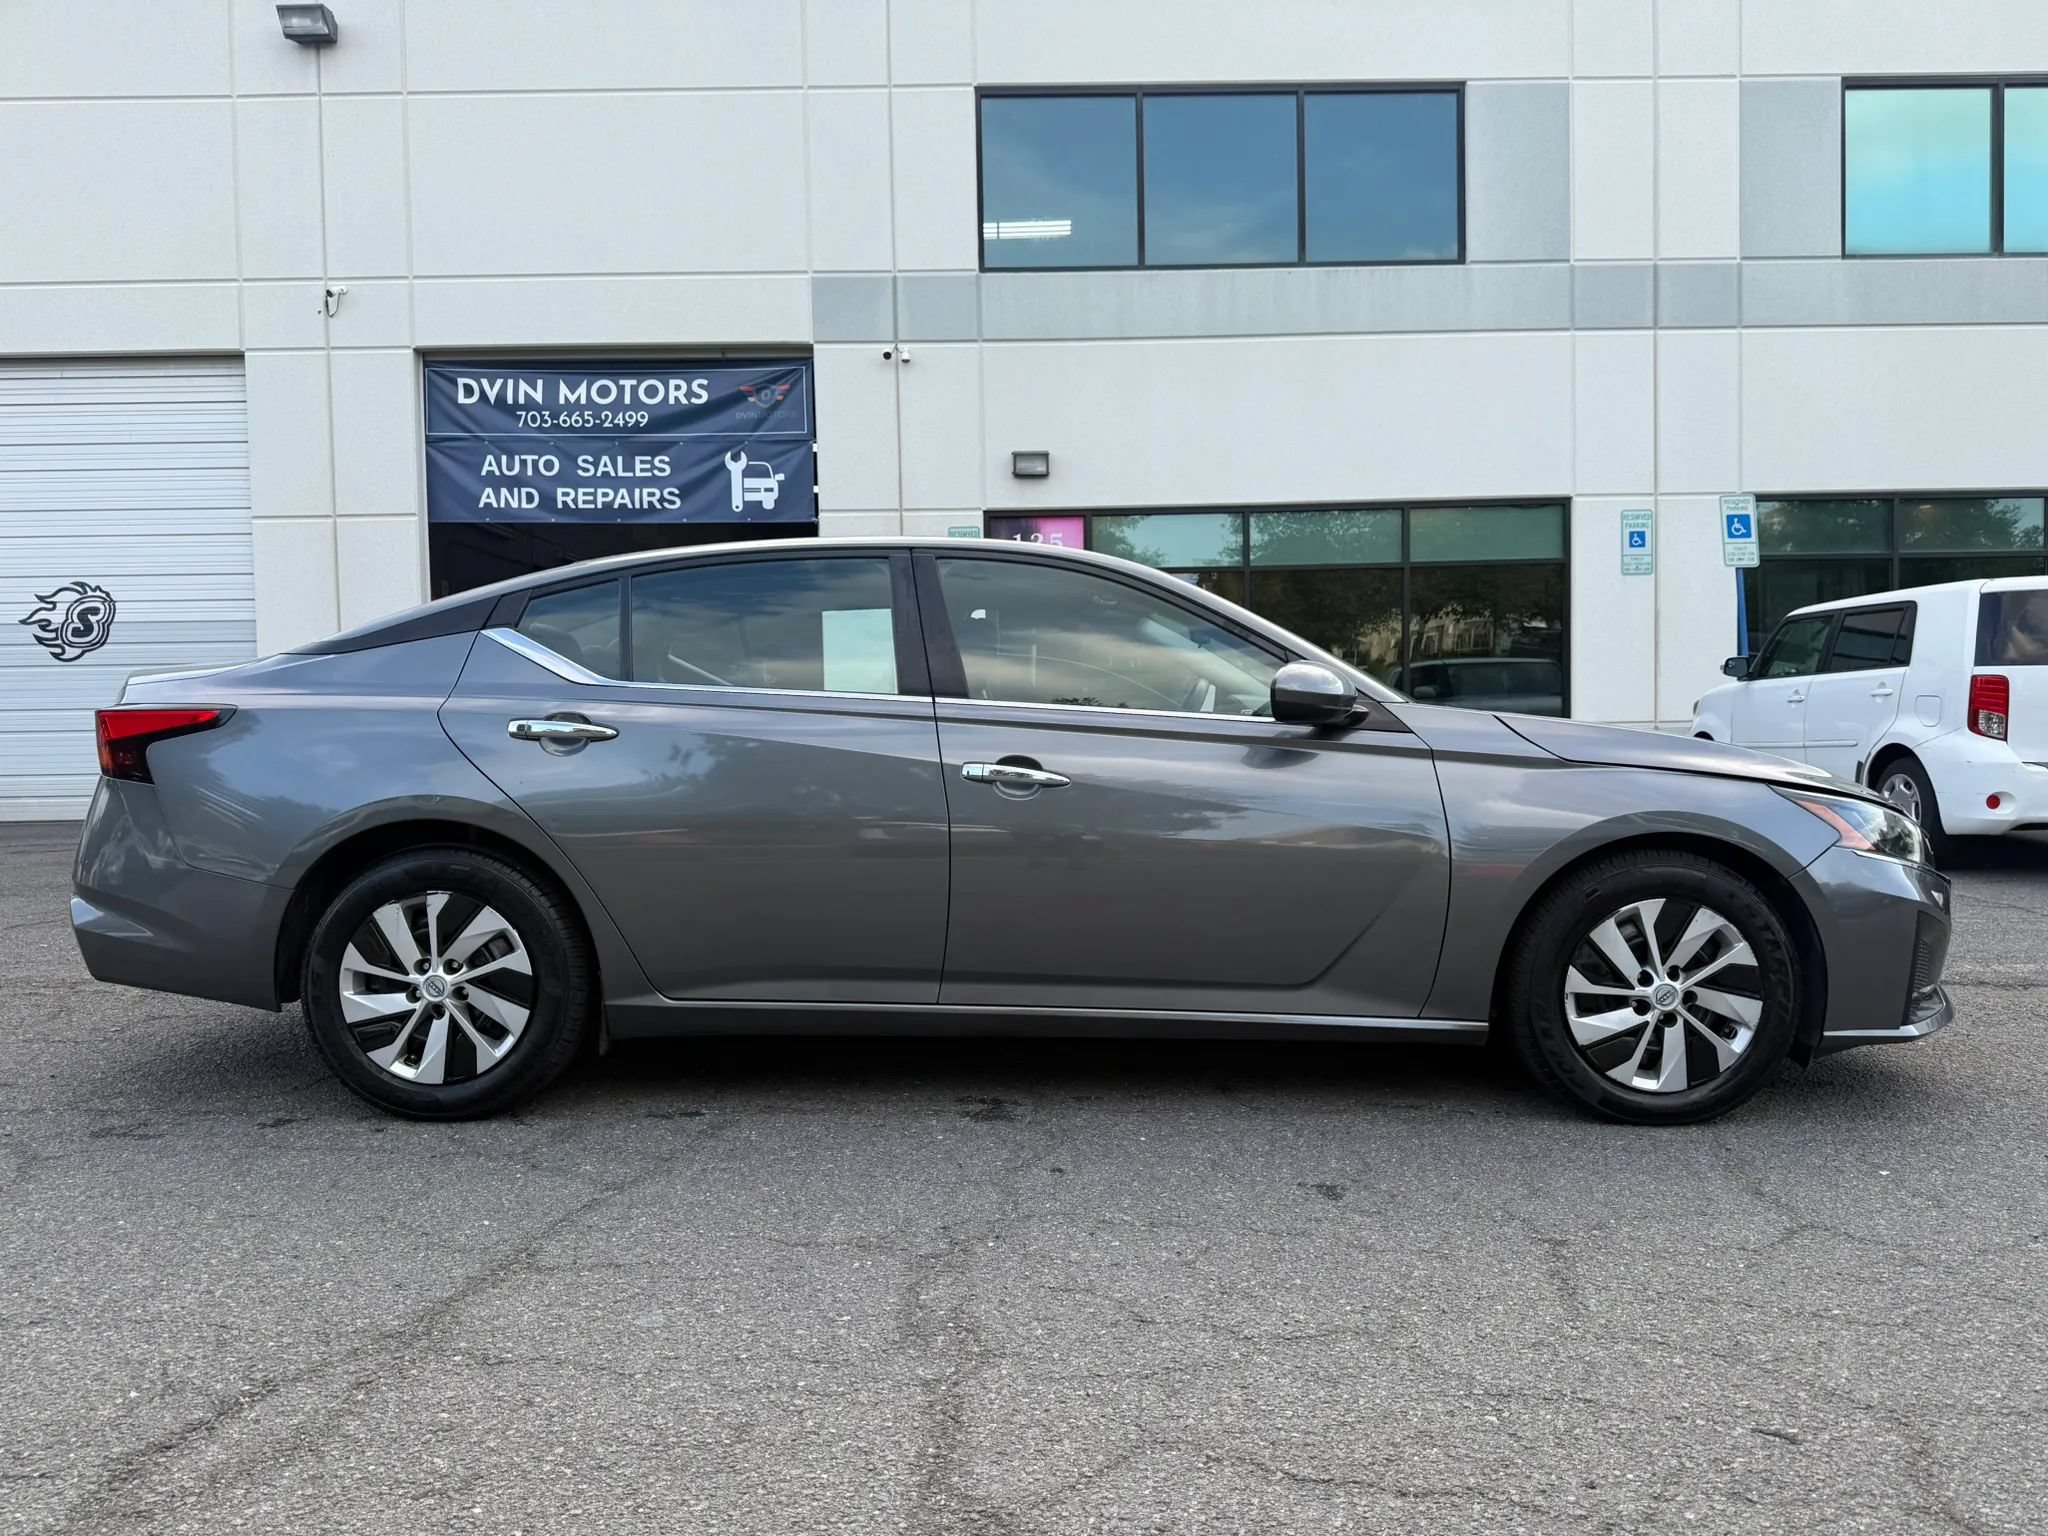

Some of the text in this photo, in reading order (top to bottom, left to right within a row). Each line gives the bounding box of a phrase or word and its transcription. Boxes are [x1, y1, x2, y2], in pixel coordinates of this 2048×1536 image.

[457, 378, 709, 405] DVIN MOTORS
[516, 411, 649, 428] 703-665-2499
[481, 454, 671, 477] AUTO SALES
[478, 487, 682, 510] AND REPAIRS
[1624, 521, 1650, 529] PARKING
